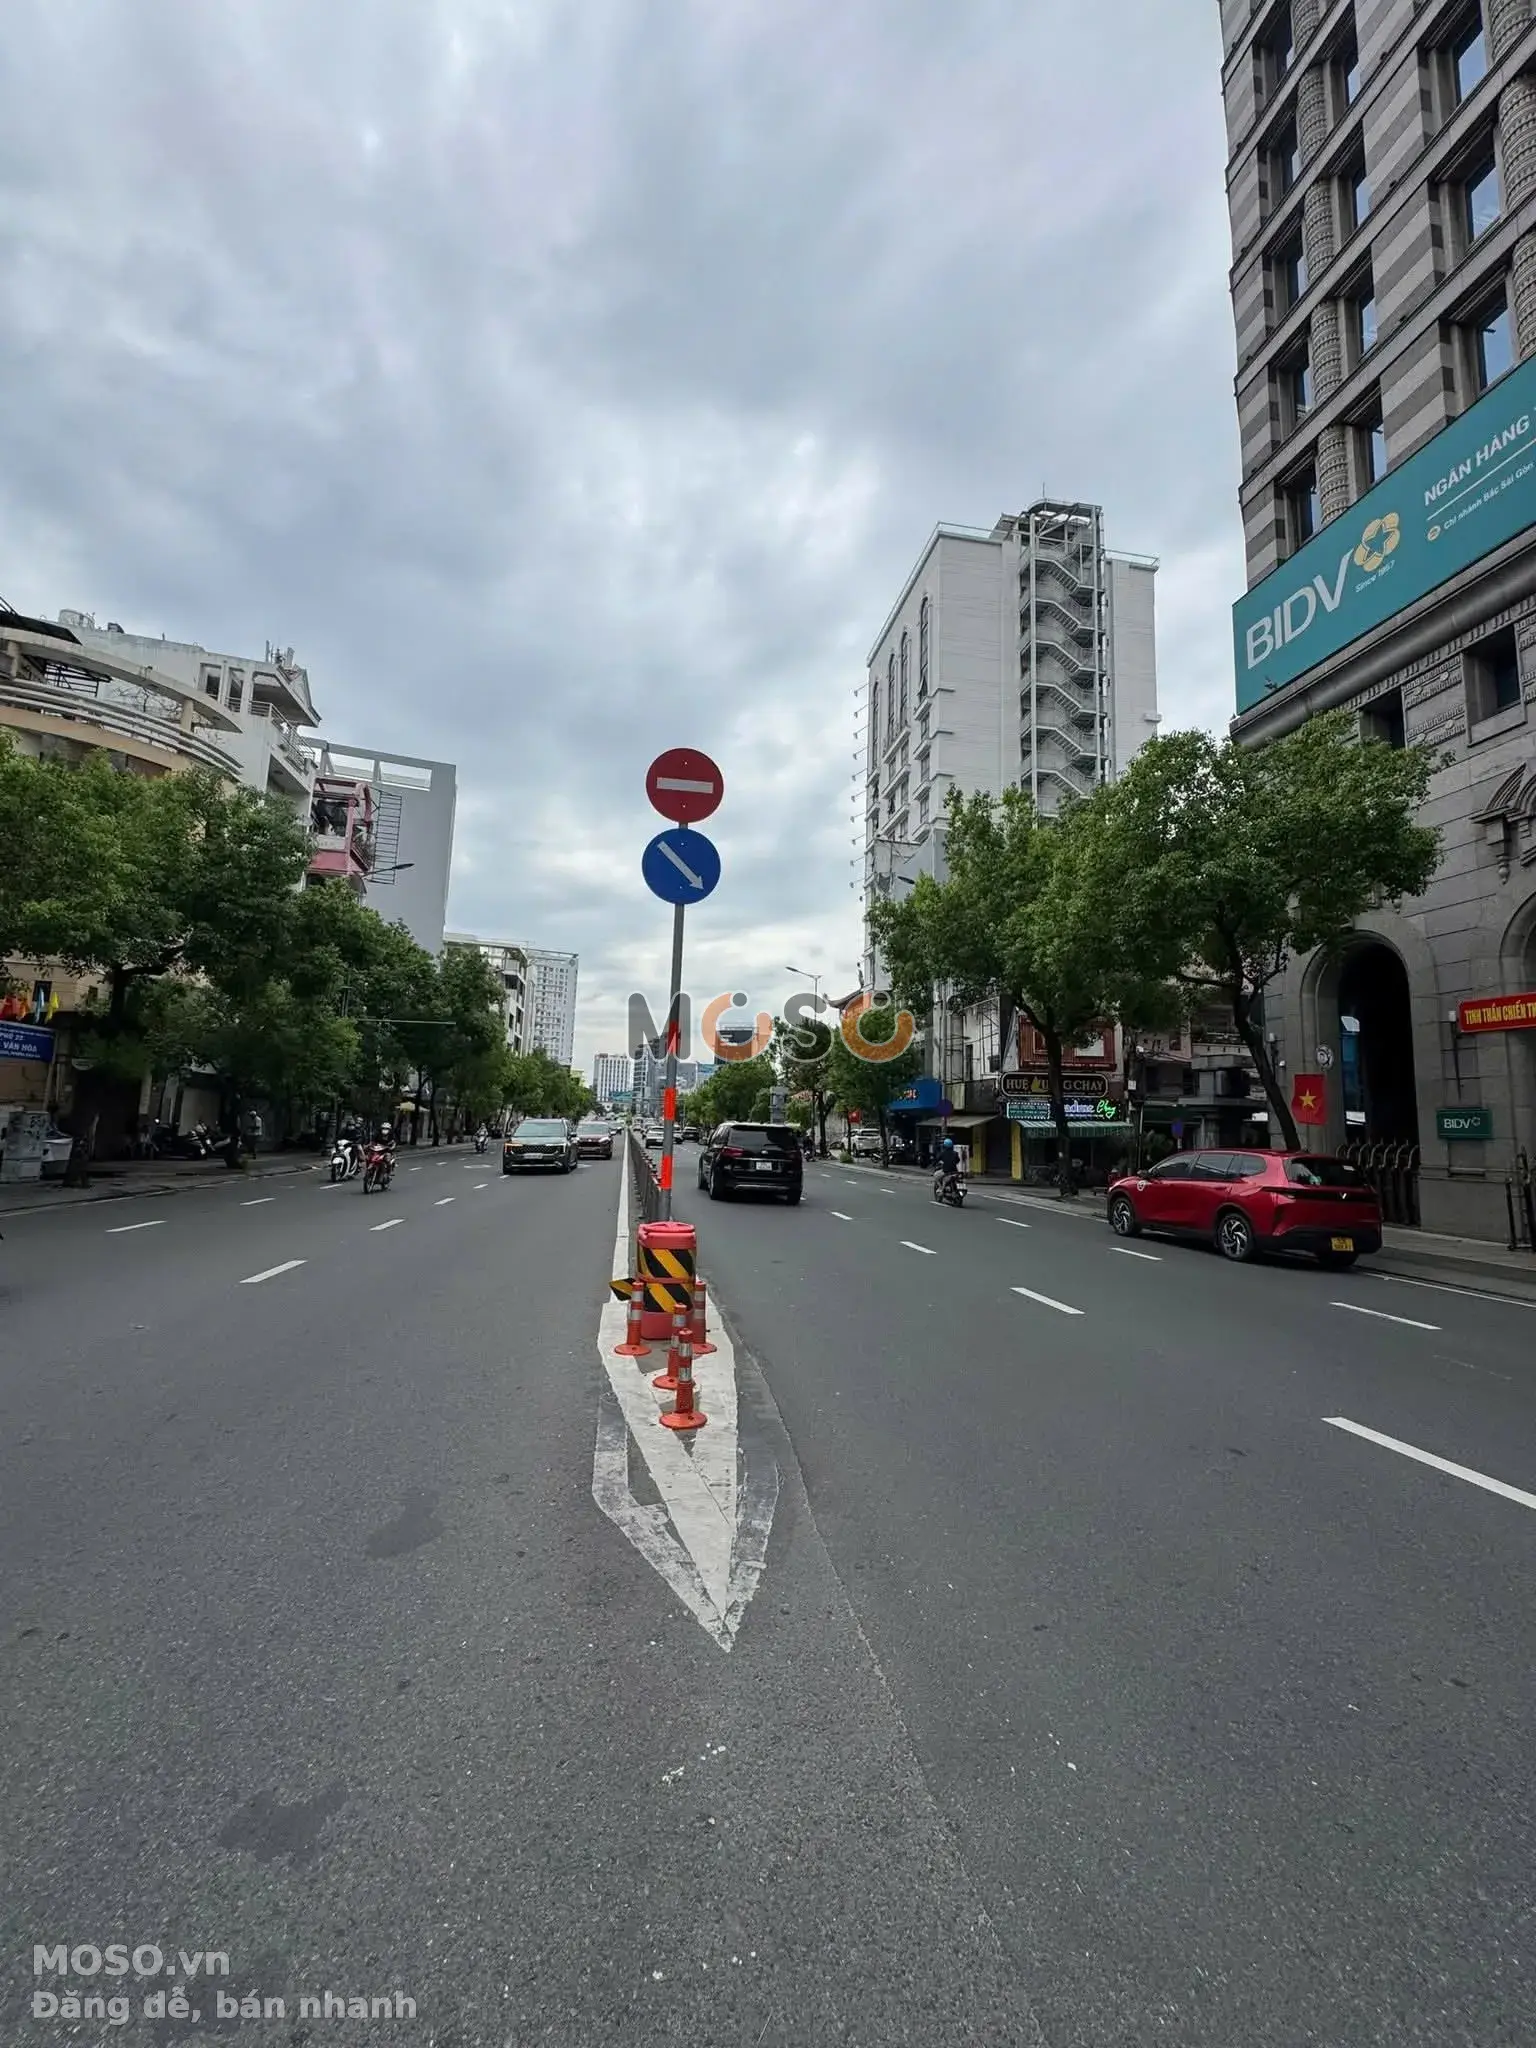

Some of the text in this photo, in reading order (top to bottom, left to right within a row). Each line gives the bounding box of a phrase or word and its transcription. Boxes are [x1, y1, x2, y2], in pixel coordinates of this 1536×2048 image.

[1424, 414, 1530, 507] NGÂN HÀNG
[1246, 548, 1354, 670] BIDV
[1443, 1118, 1471, 1129] BIDV
